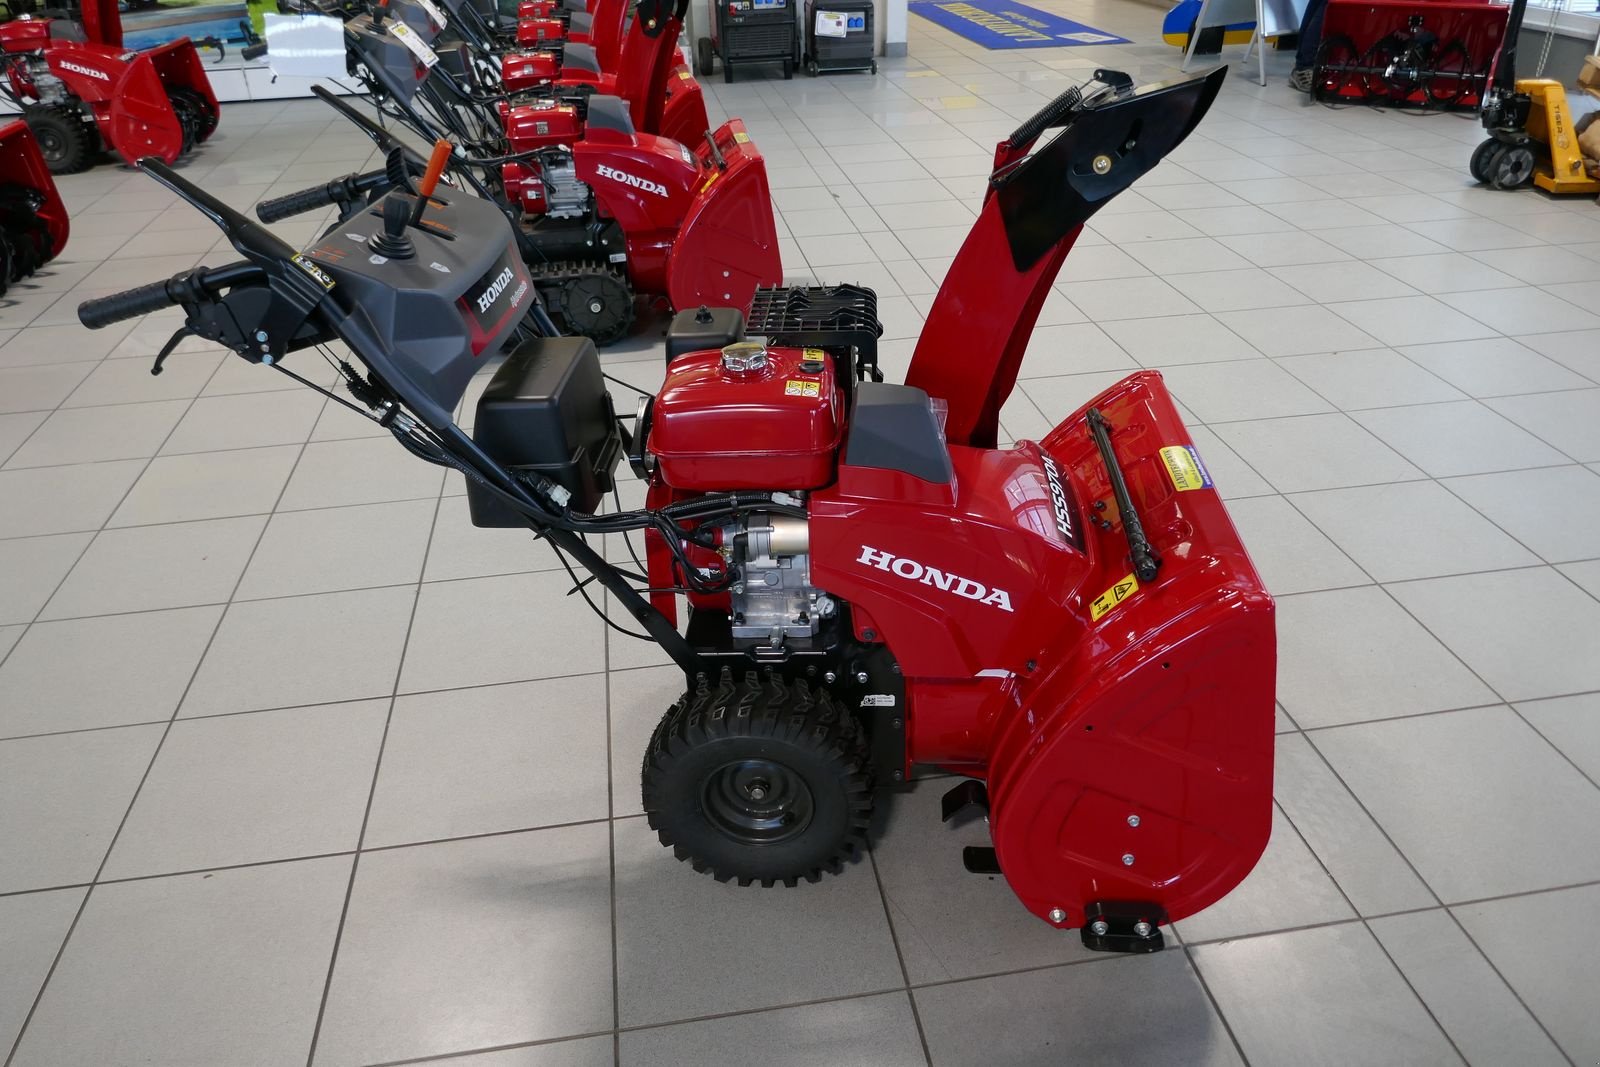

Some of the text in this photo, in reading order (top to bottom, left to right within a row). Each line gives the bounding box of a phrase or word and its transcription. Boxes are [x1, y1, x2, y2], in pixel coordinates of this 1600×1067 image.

[59, 60, 110, 81] HONDA
[596, 164, 669, 198] HONDA
[476, 266, 514, 313] HONDA
[1041, 455, 1074, 538] HSS970A
[856, 545, 1014, 613] HONDA
